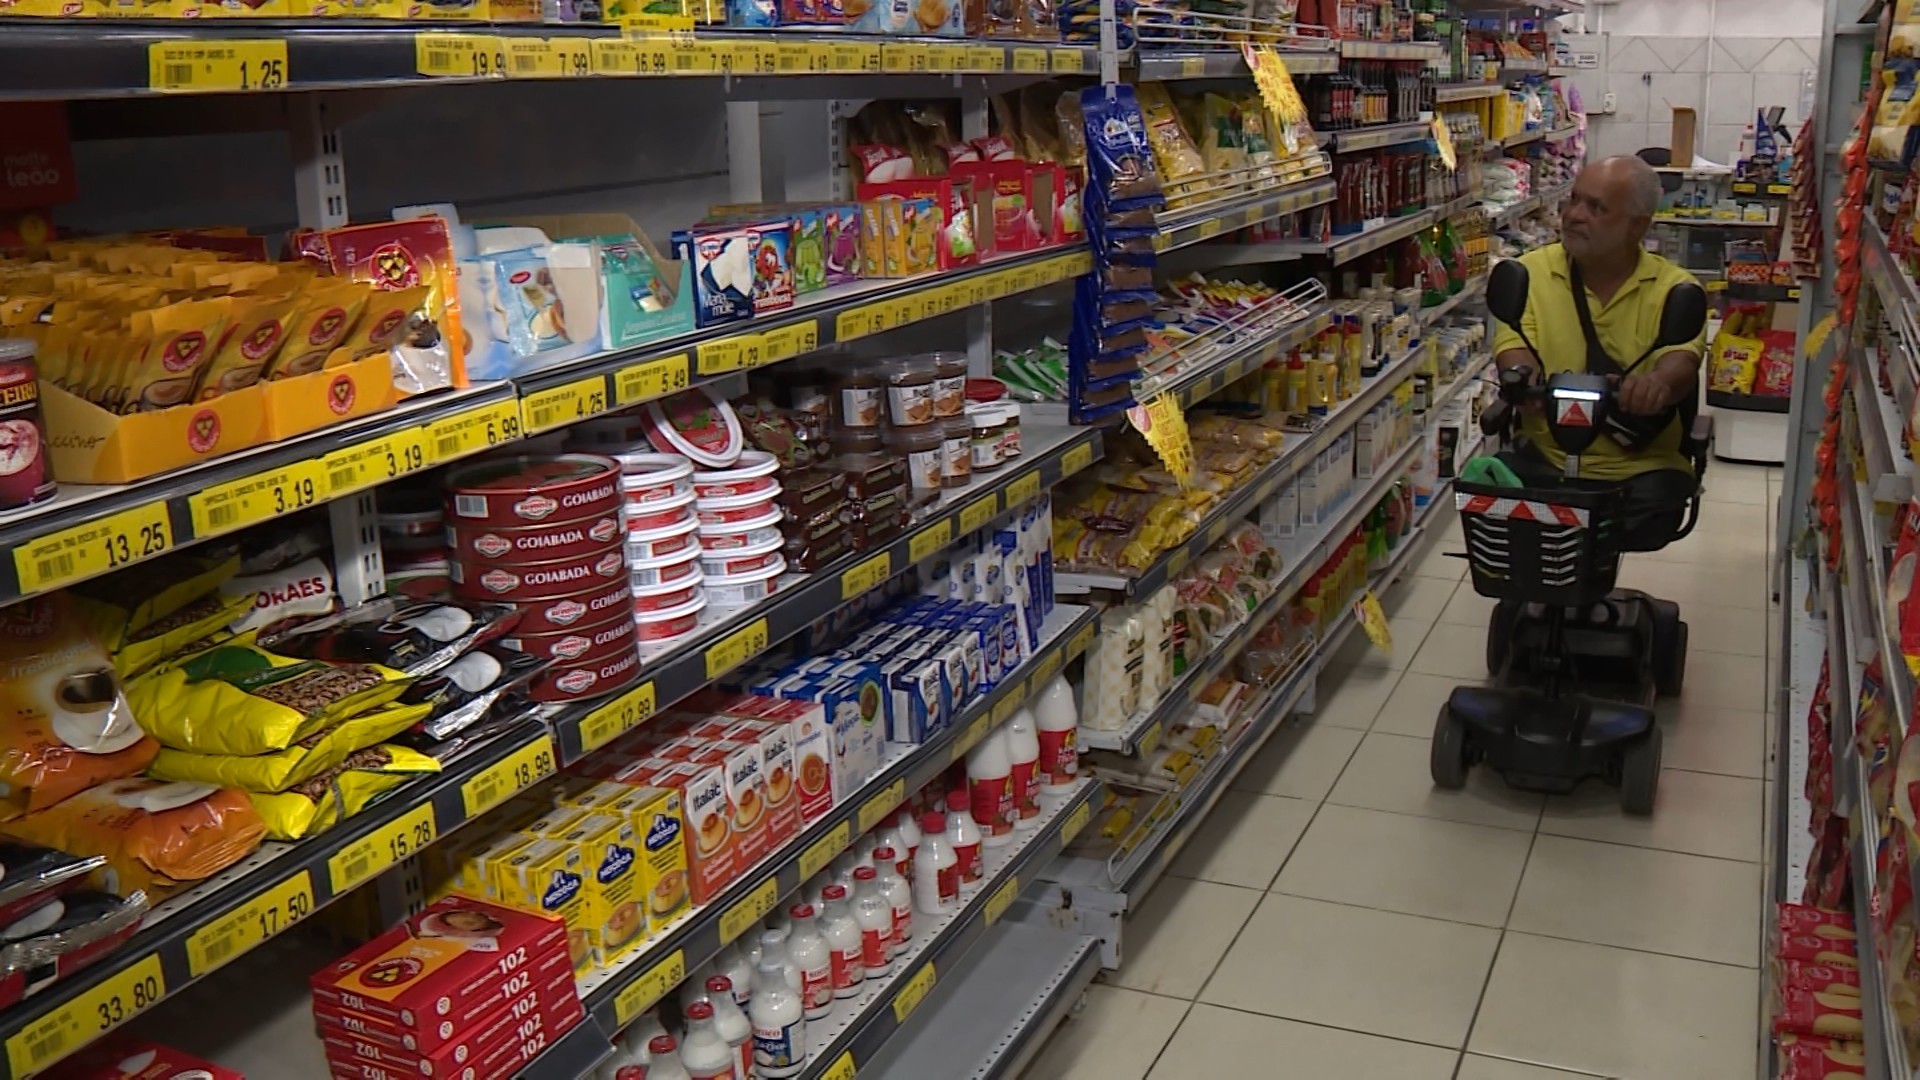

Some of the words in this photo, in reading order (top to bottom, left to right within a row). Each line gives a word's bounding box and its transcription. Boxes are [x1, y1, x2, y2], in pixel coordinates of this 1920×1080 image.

[240, 60, 282, 90] 1.25
[558, 53, 588, 77] 7.99
[635, 53, 666, 73] 16.99
[0, 381, 38, 406] EIRO
[662, 368, 685, 393] 5.49
[577, 391, 603, 418] 4.25
[487, 416, 519, 446] 6.99
[387, 444, 422, 477] 3.19
[274, 478, 313, 513] 3.19
[562, 483, 615, 508] GOIABADA
[105, 522, 165, 568] 13.25
[516, 530, 584, 549] GOIABADA
[525, 565, 592, 585] GOIABADA
[621, 697, 651, 730] 12.99
[514, 751, 551, 789] 18.99
[389, 820, 432, 862] 15.28
[258, 892, 309, 939] 17.50
[499, 946, 528, 976] 102
[501, 971, 532, 999] 102
[98, 976, 157, 1030] 33.80
[511, 991, 539, 1020] 102
[517, 1012, 543, 1041] 102
[520, 1032, 547, 1060] 102
